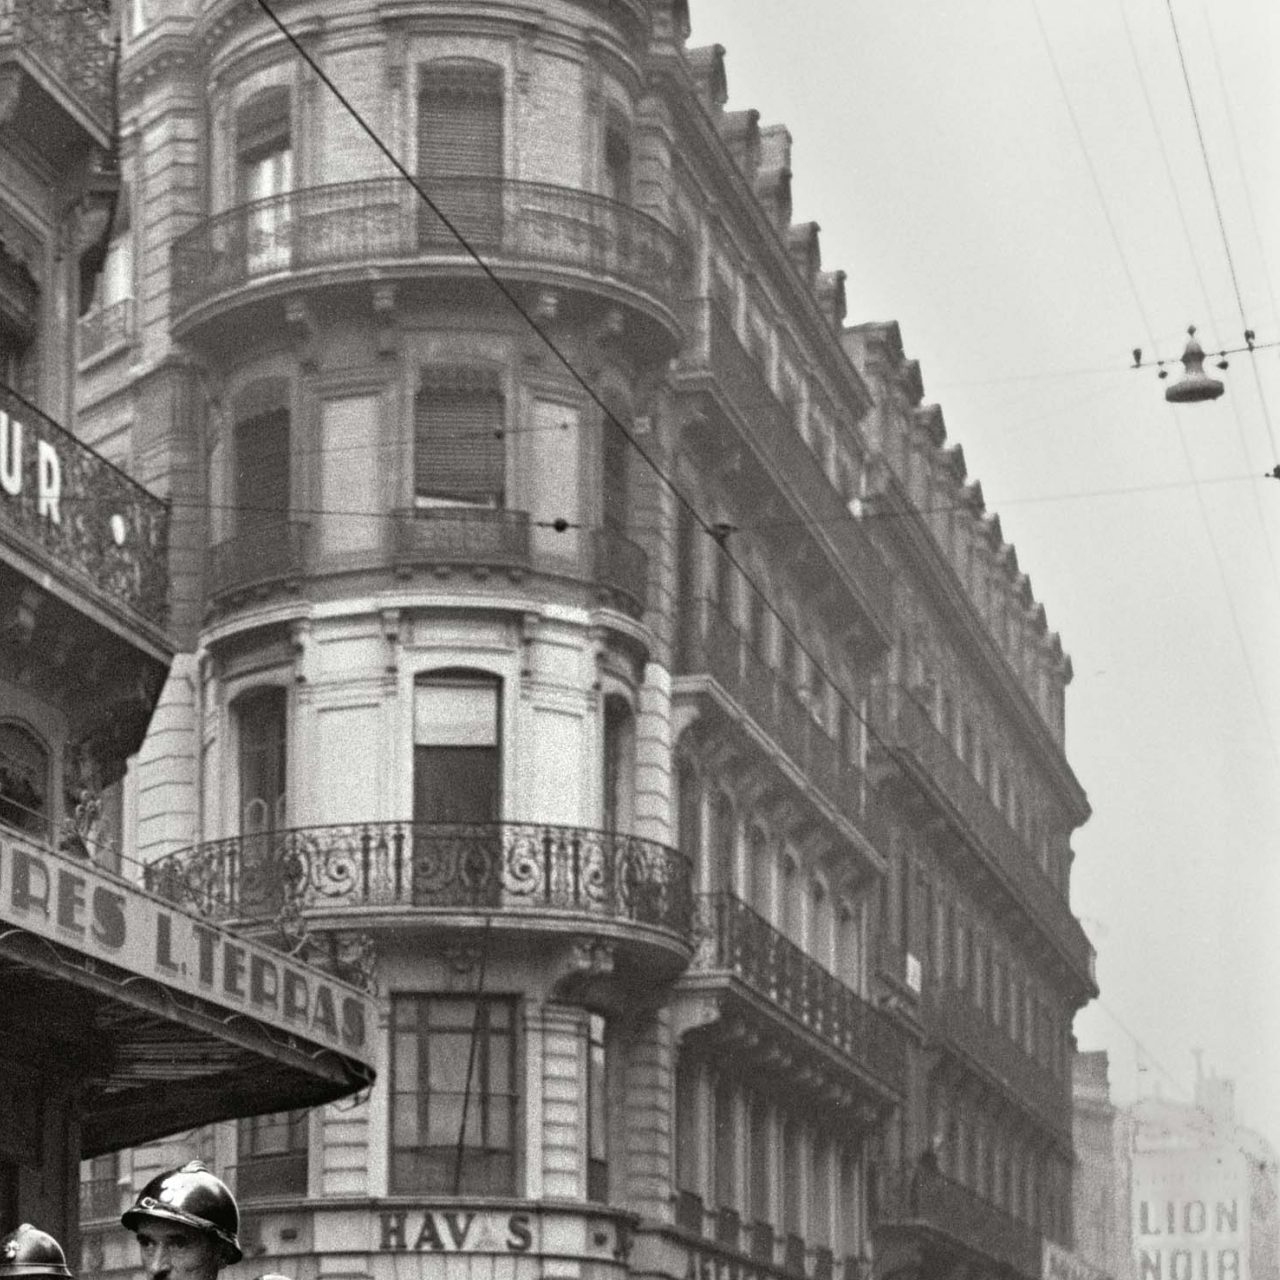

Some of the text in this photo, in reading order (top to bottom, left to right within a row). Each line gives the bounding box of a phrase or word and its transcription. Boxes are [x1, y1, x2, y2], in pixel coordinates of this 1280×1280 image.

[191, 922, 366, 1048] TERRAS
[379, 1210, 533, 1252] HAVS
[1138, 1199, 1239, 1236] LION
